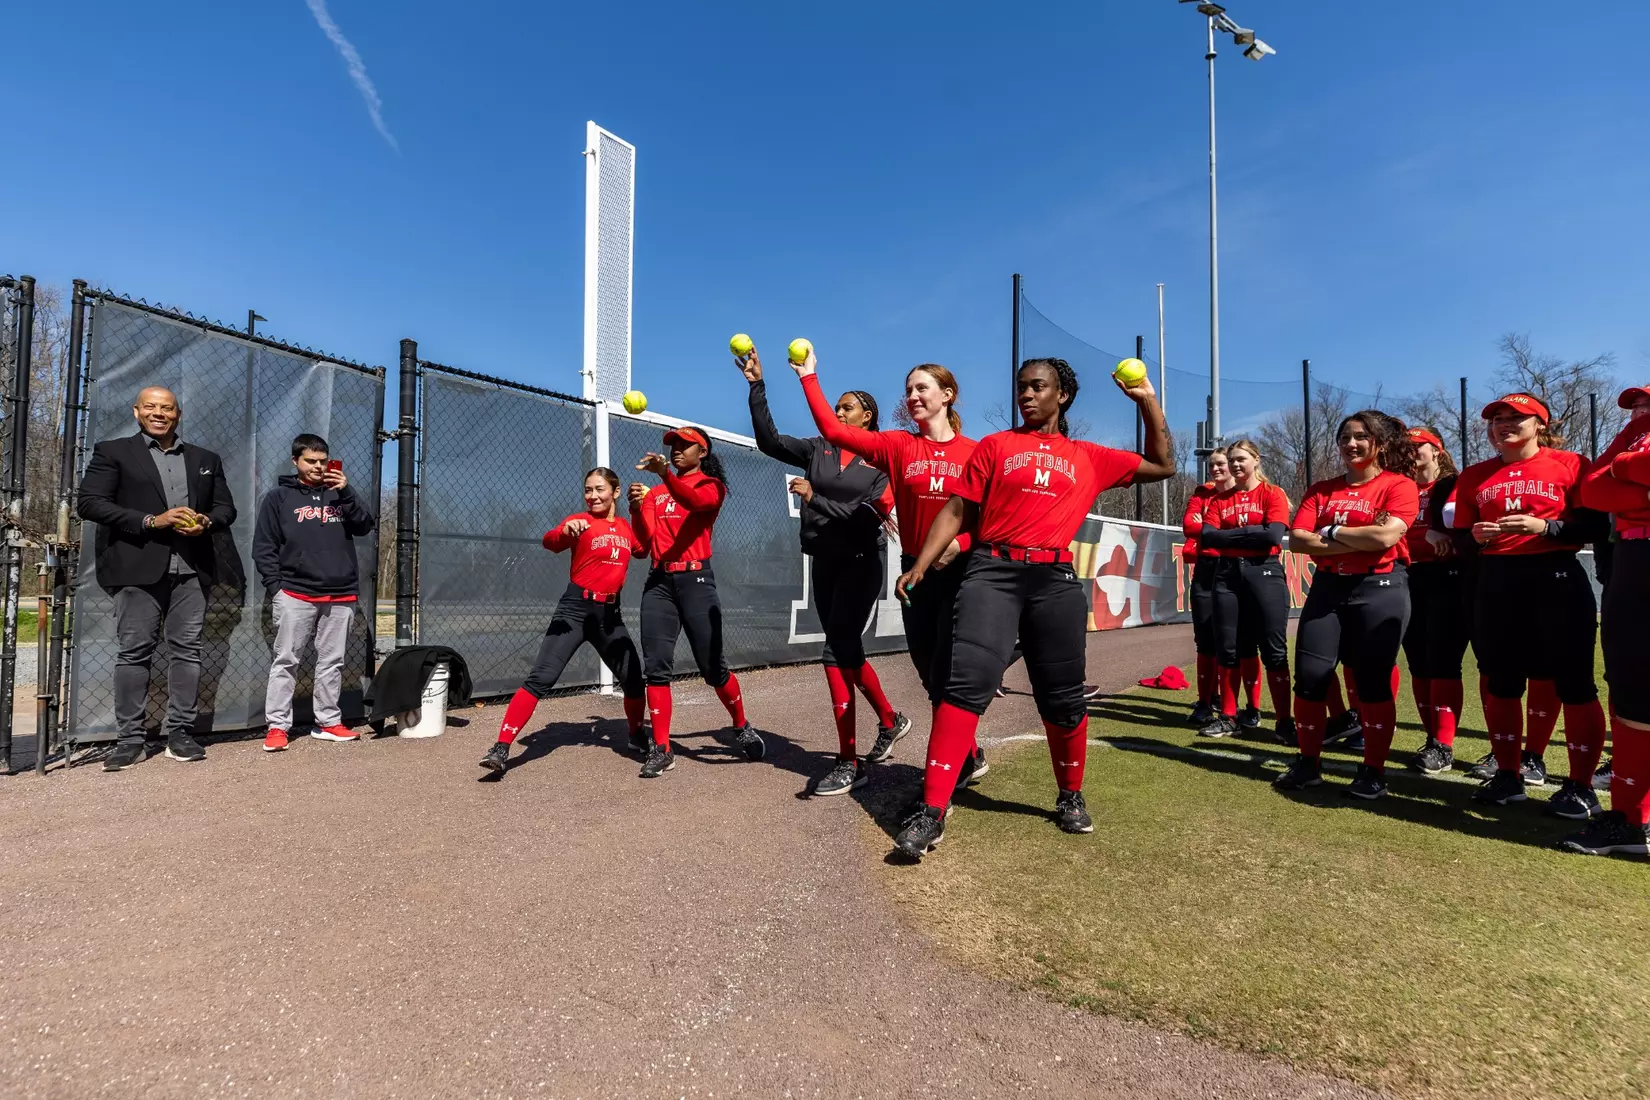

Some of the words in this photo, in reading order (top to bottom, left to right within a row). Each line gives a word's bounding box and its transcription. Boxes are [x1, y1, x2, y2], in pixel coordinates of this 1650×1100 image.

[1004, 451, 1077, 485] SOFTBALL
[929, 476, 945, 493] M
[1033, 468, 1051, 487] M
[1476, 480, 1559, 508] SOFTBALL
[664, 501, 677, 513] M
[1505, 496, 1522, 512] M
[1238, 513, 1249, 527] M
[1333, 511, 1349, 525] M
[610, 547, 620, 560] M
